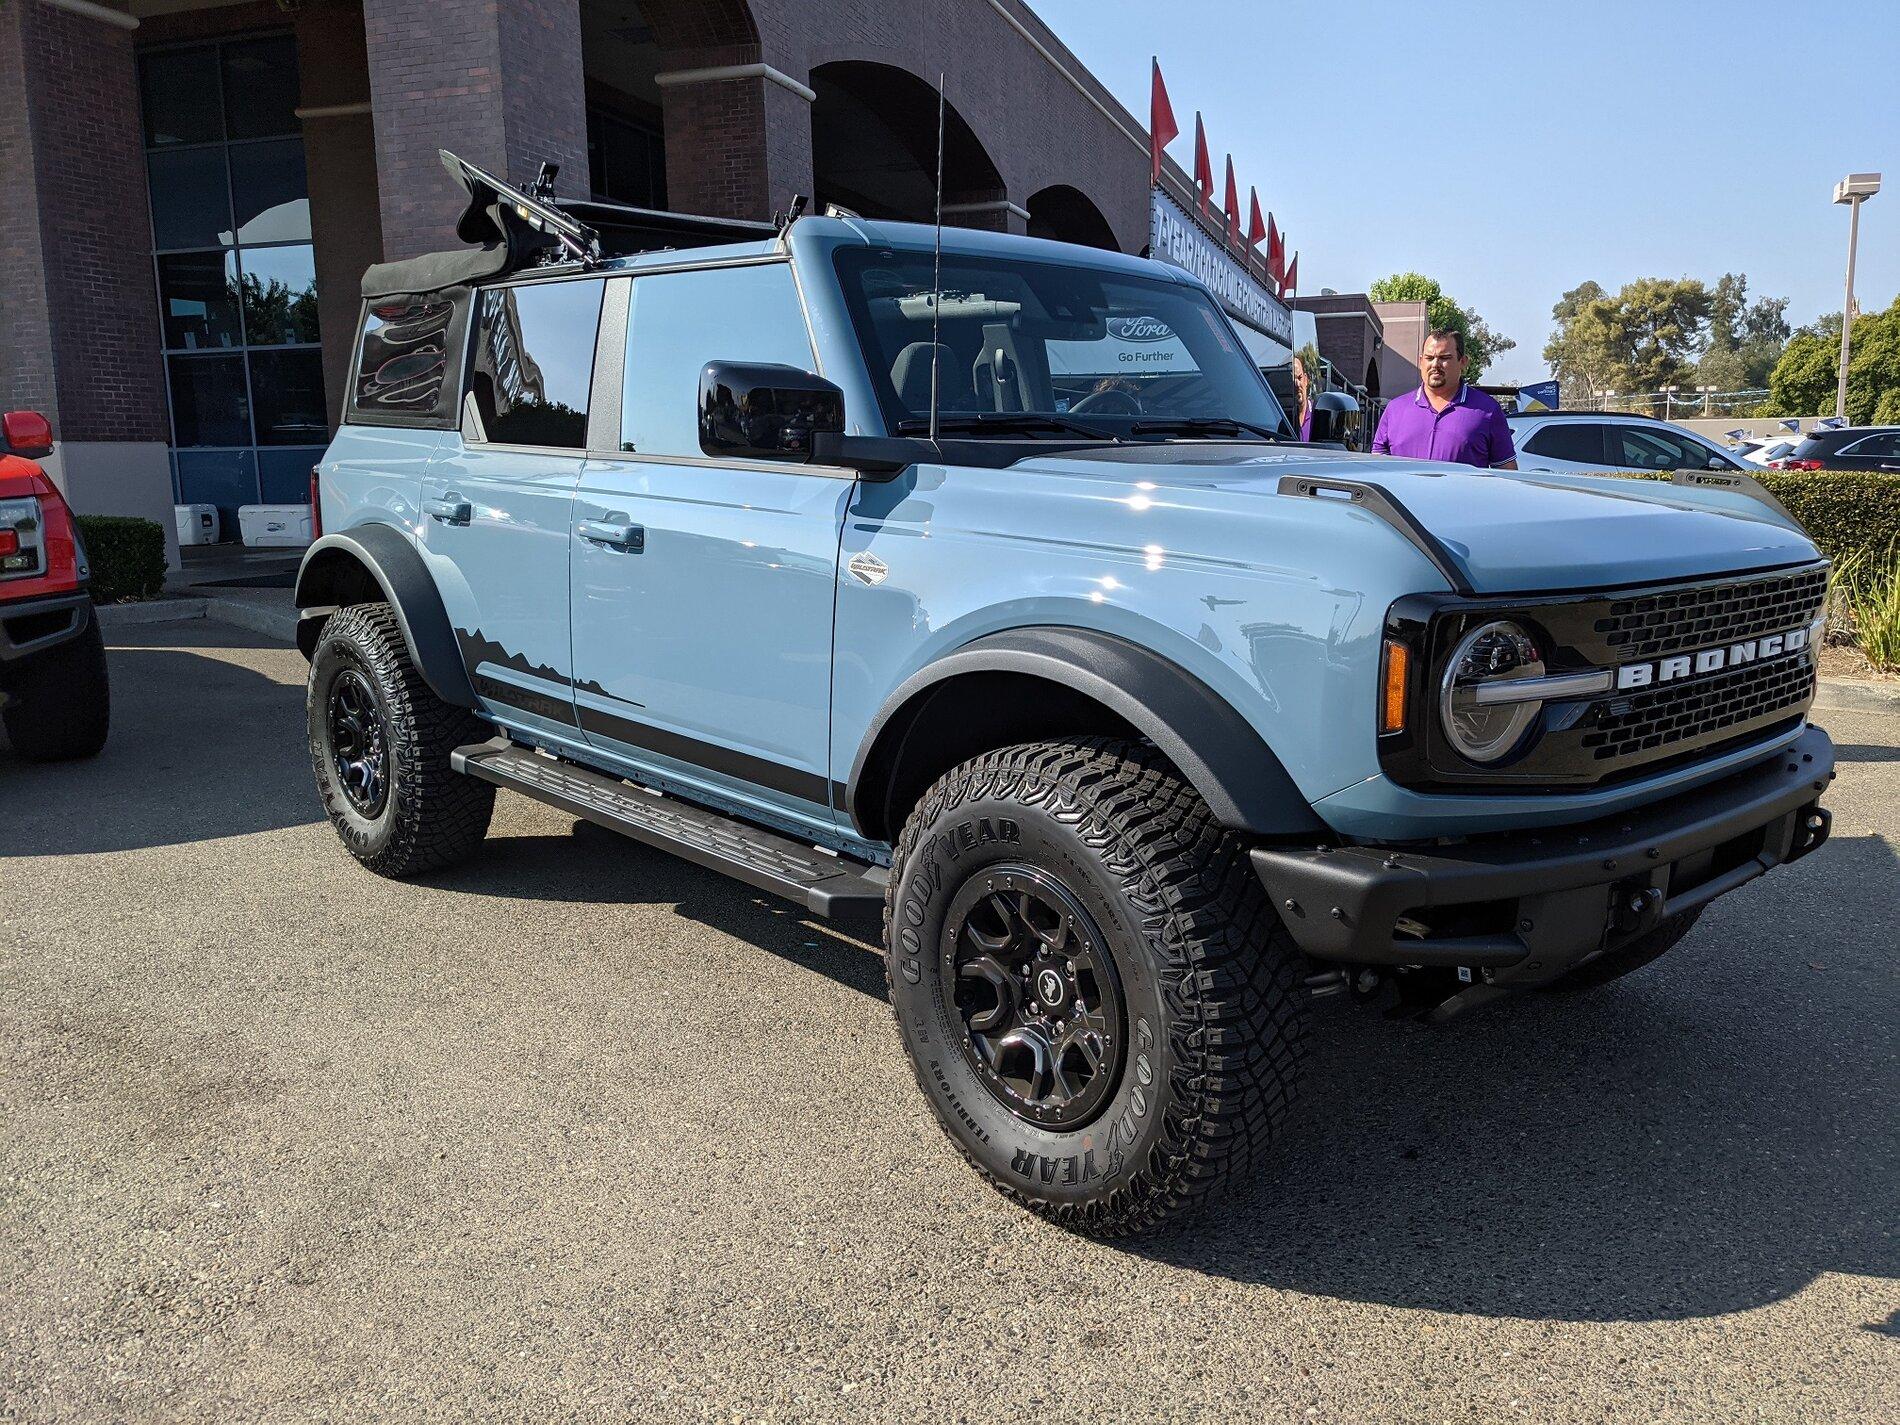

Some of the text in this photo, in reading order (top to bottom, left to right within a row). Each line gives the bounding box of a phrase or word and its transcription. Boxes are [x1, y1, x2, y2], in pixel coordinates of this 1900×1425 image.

[1118, 350, 1174, 362] Go Further
[1617, 627, 1810, 690] BRONCO
[929, 1059, 992, 1147] TERRITORY
